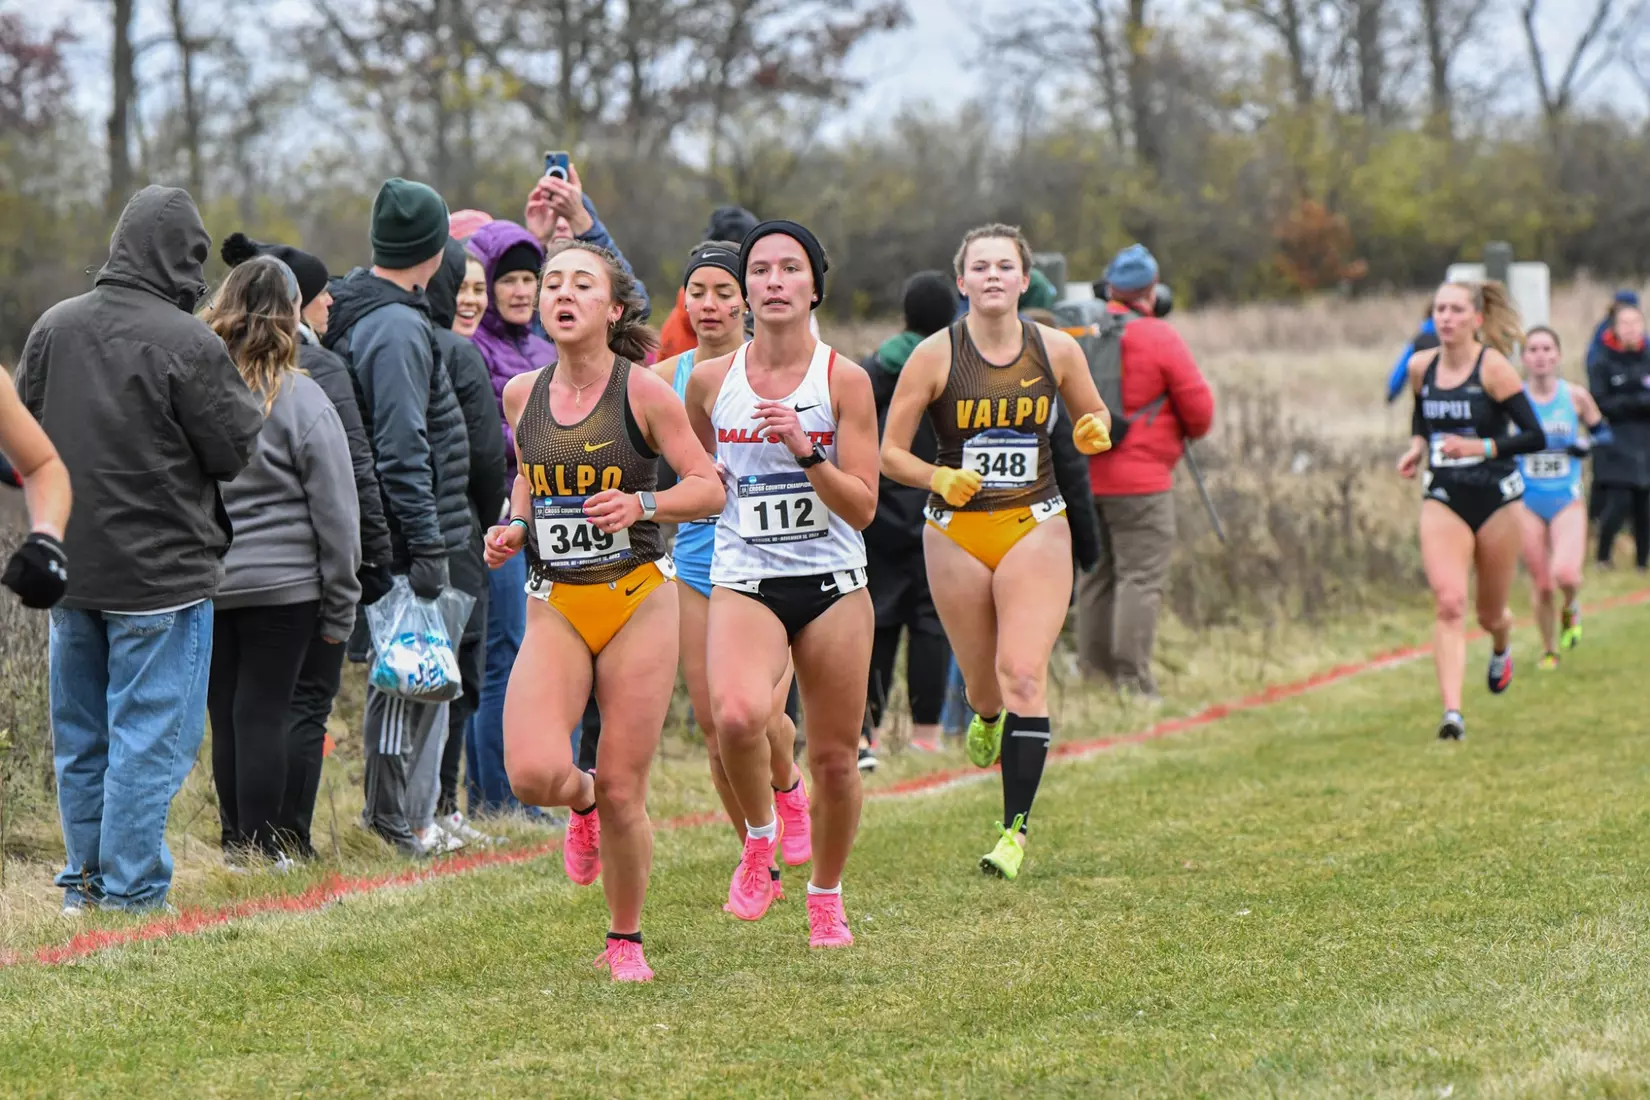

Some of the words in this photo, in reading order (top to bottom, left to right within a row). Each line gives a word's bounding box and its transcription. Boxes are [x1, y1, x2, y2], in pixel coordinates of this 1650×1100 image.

[956, 395, 1049, 429] VALPO
[718, 428, 763, 444] BALL
[974, 452, 1026, 477] 348
[765, 483, 787, 491] COUNTRY
[753, 497, 815, 531] 112
[549, 524, 614, 554] 349
